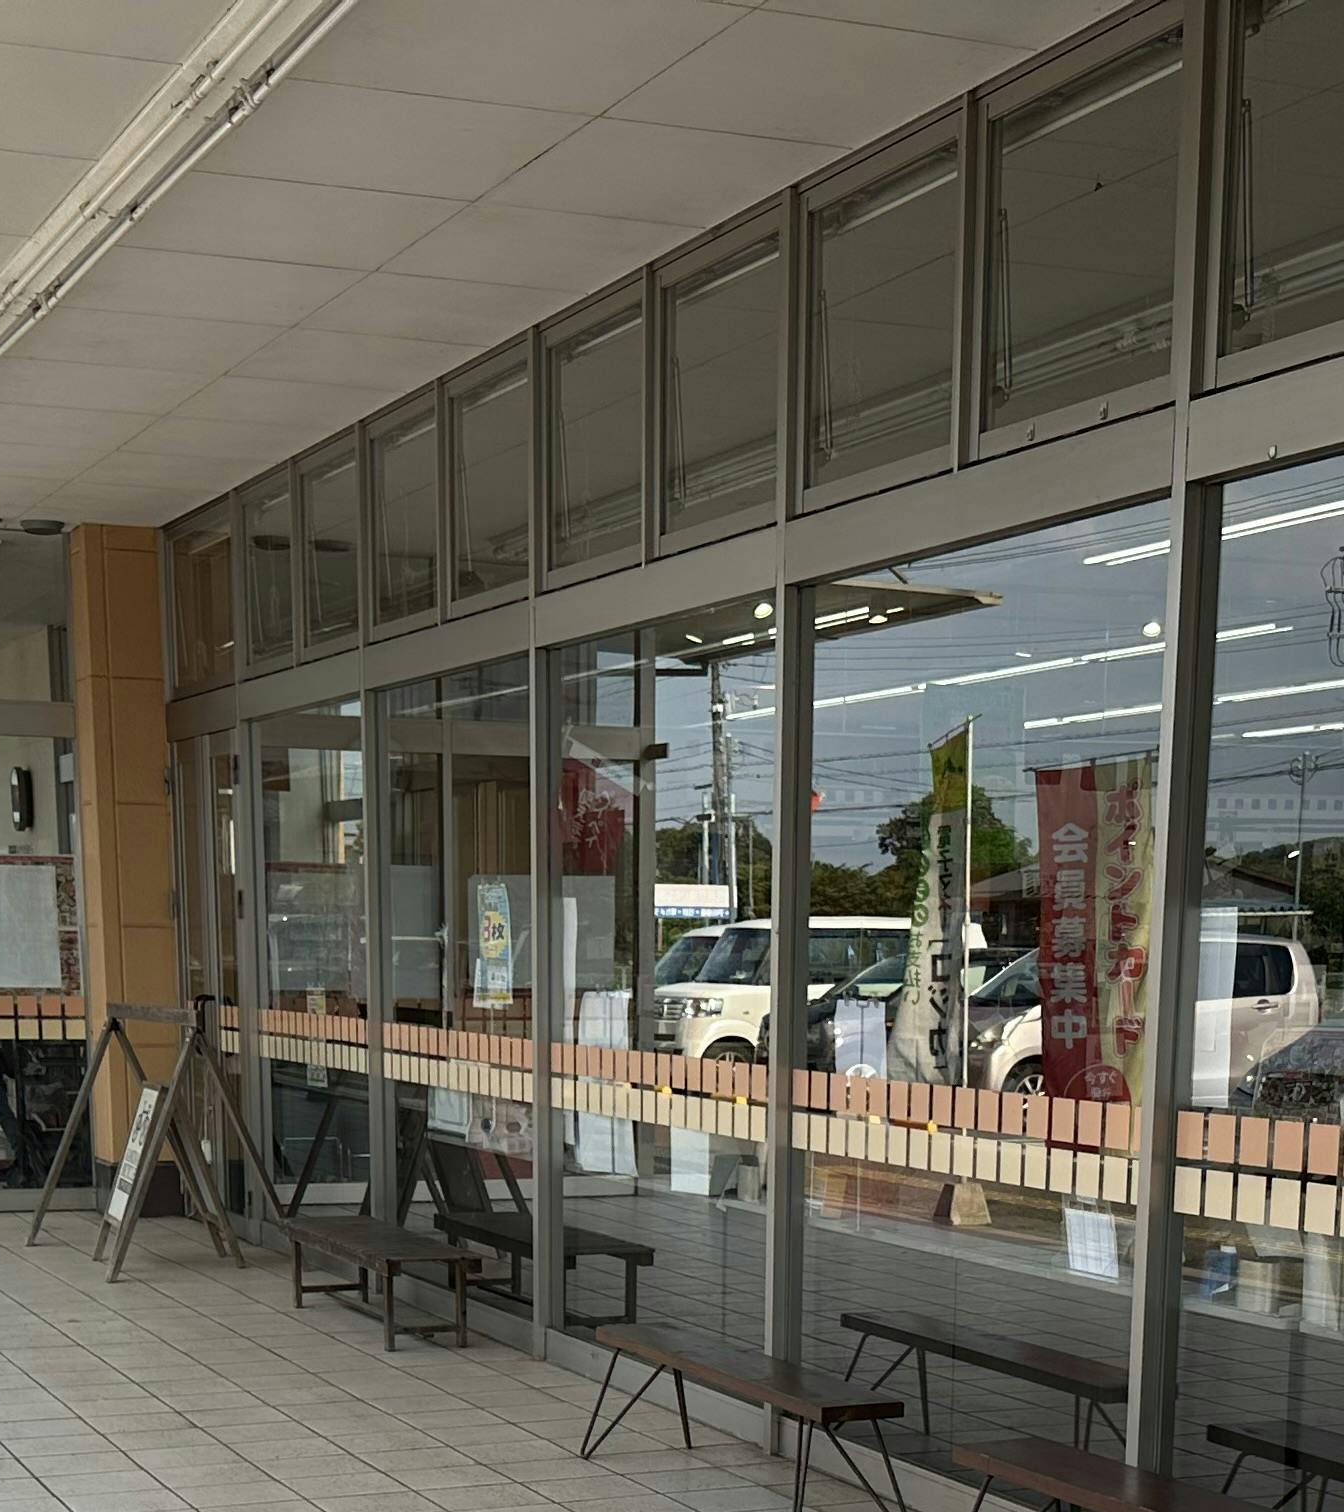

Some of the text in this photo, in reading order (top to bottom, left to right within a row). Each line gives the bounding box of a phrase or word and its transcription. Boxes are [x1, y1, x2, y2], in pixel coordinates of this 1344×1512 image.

[1049, 822, 1090, 1050] 会員募集中
[1104, 777, 1147, 1060] ポイントカード
